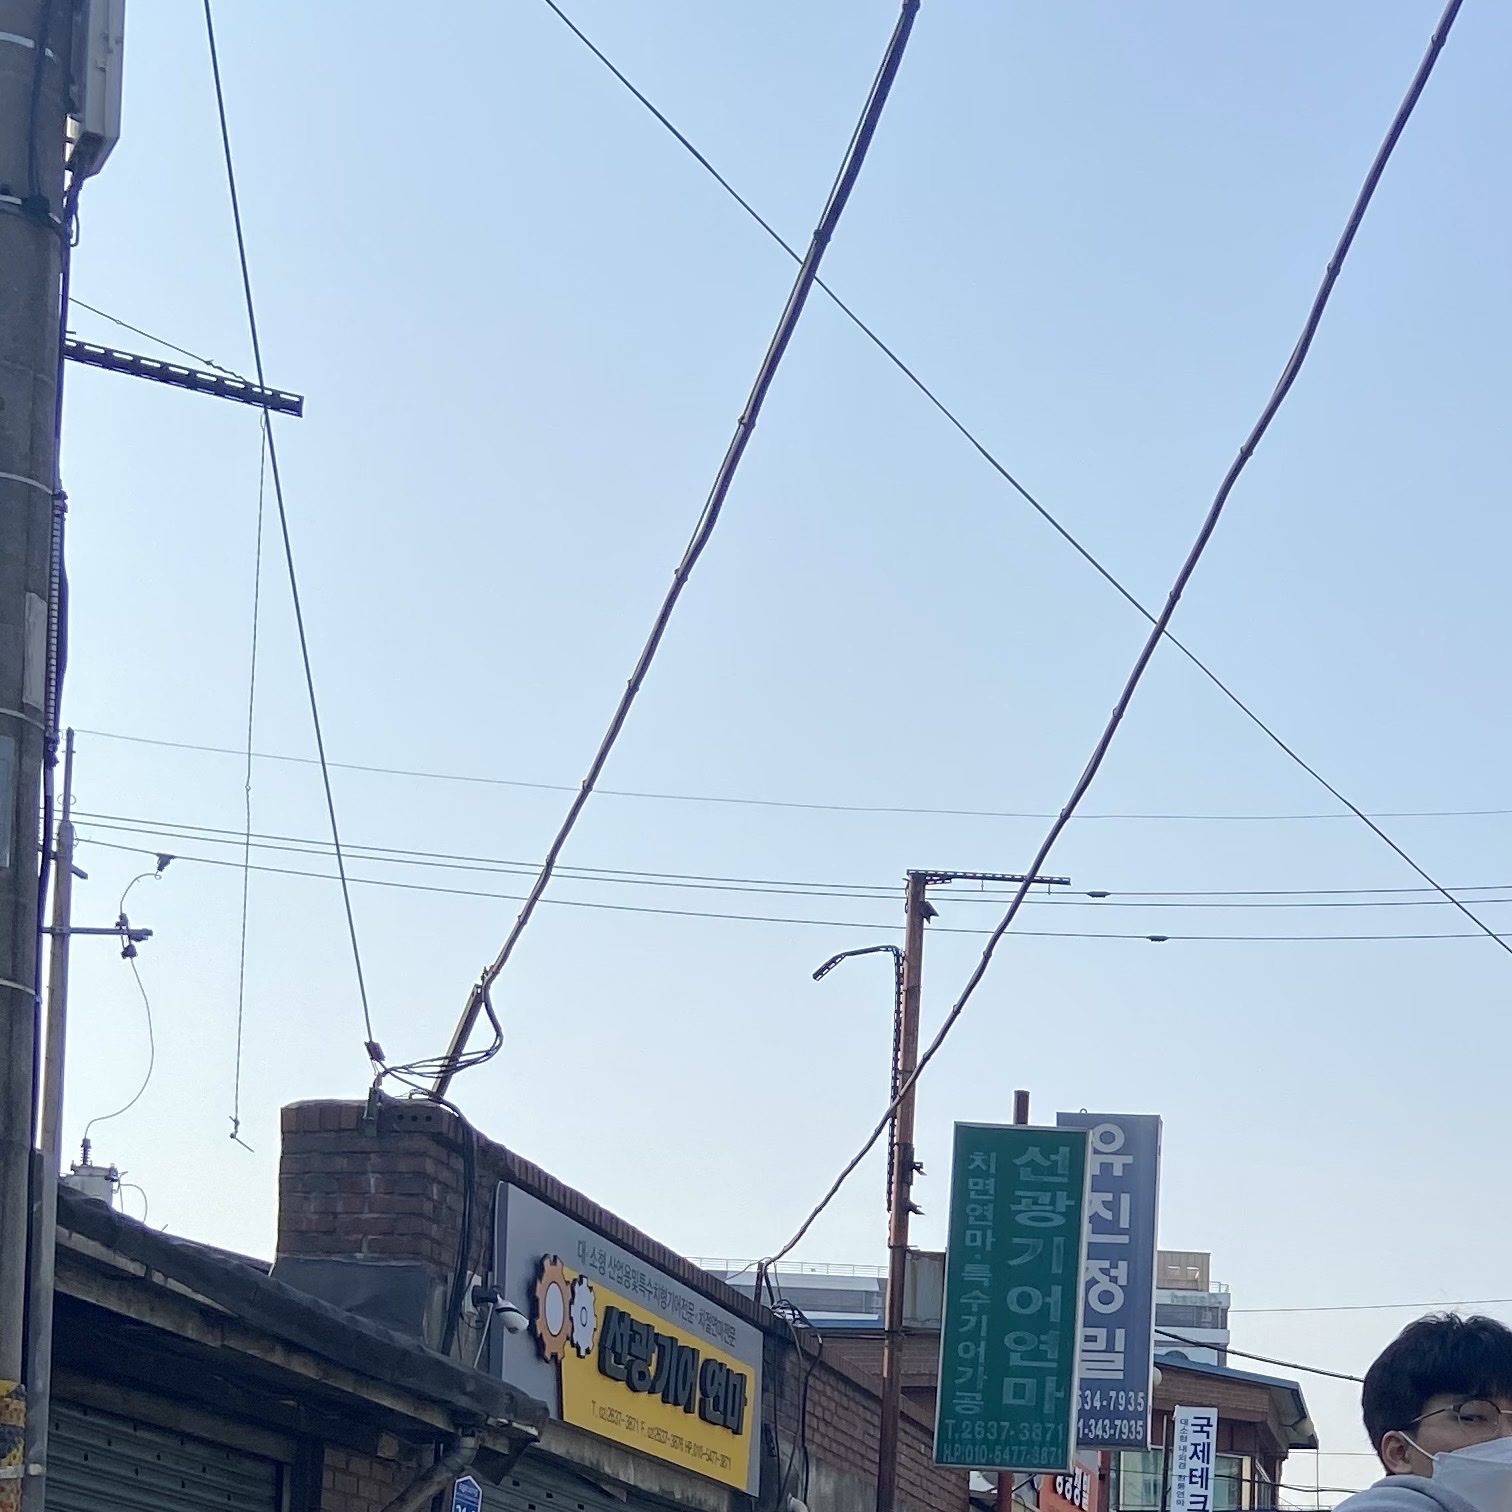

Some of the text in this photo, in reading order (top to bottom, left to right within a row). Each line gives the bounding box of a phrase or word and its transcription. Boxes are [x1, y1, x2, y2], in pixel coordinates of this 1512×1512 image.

[1080, 1123, 1134, 1380] 유진정밀
[598, 1305, 747, 1435] 선광기어 연마
[1187, 1416, 1213, 1512] 국제테크
